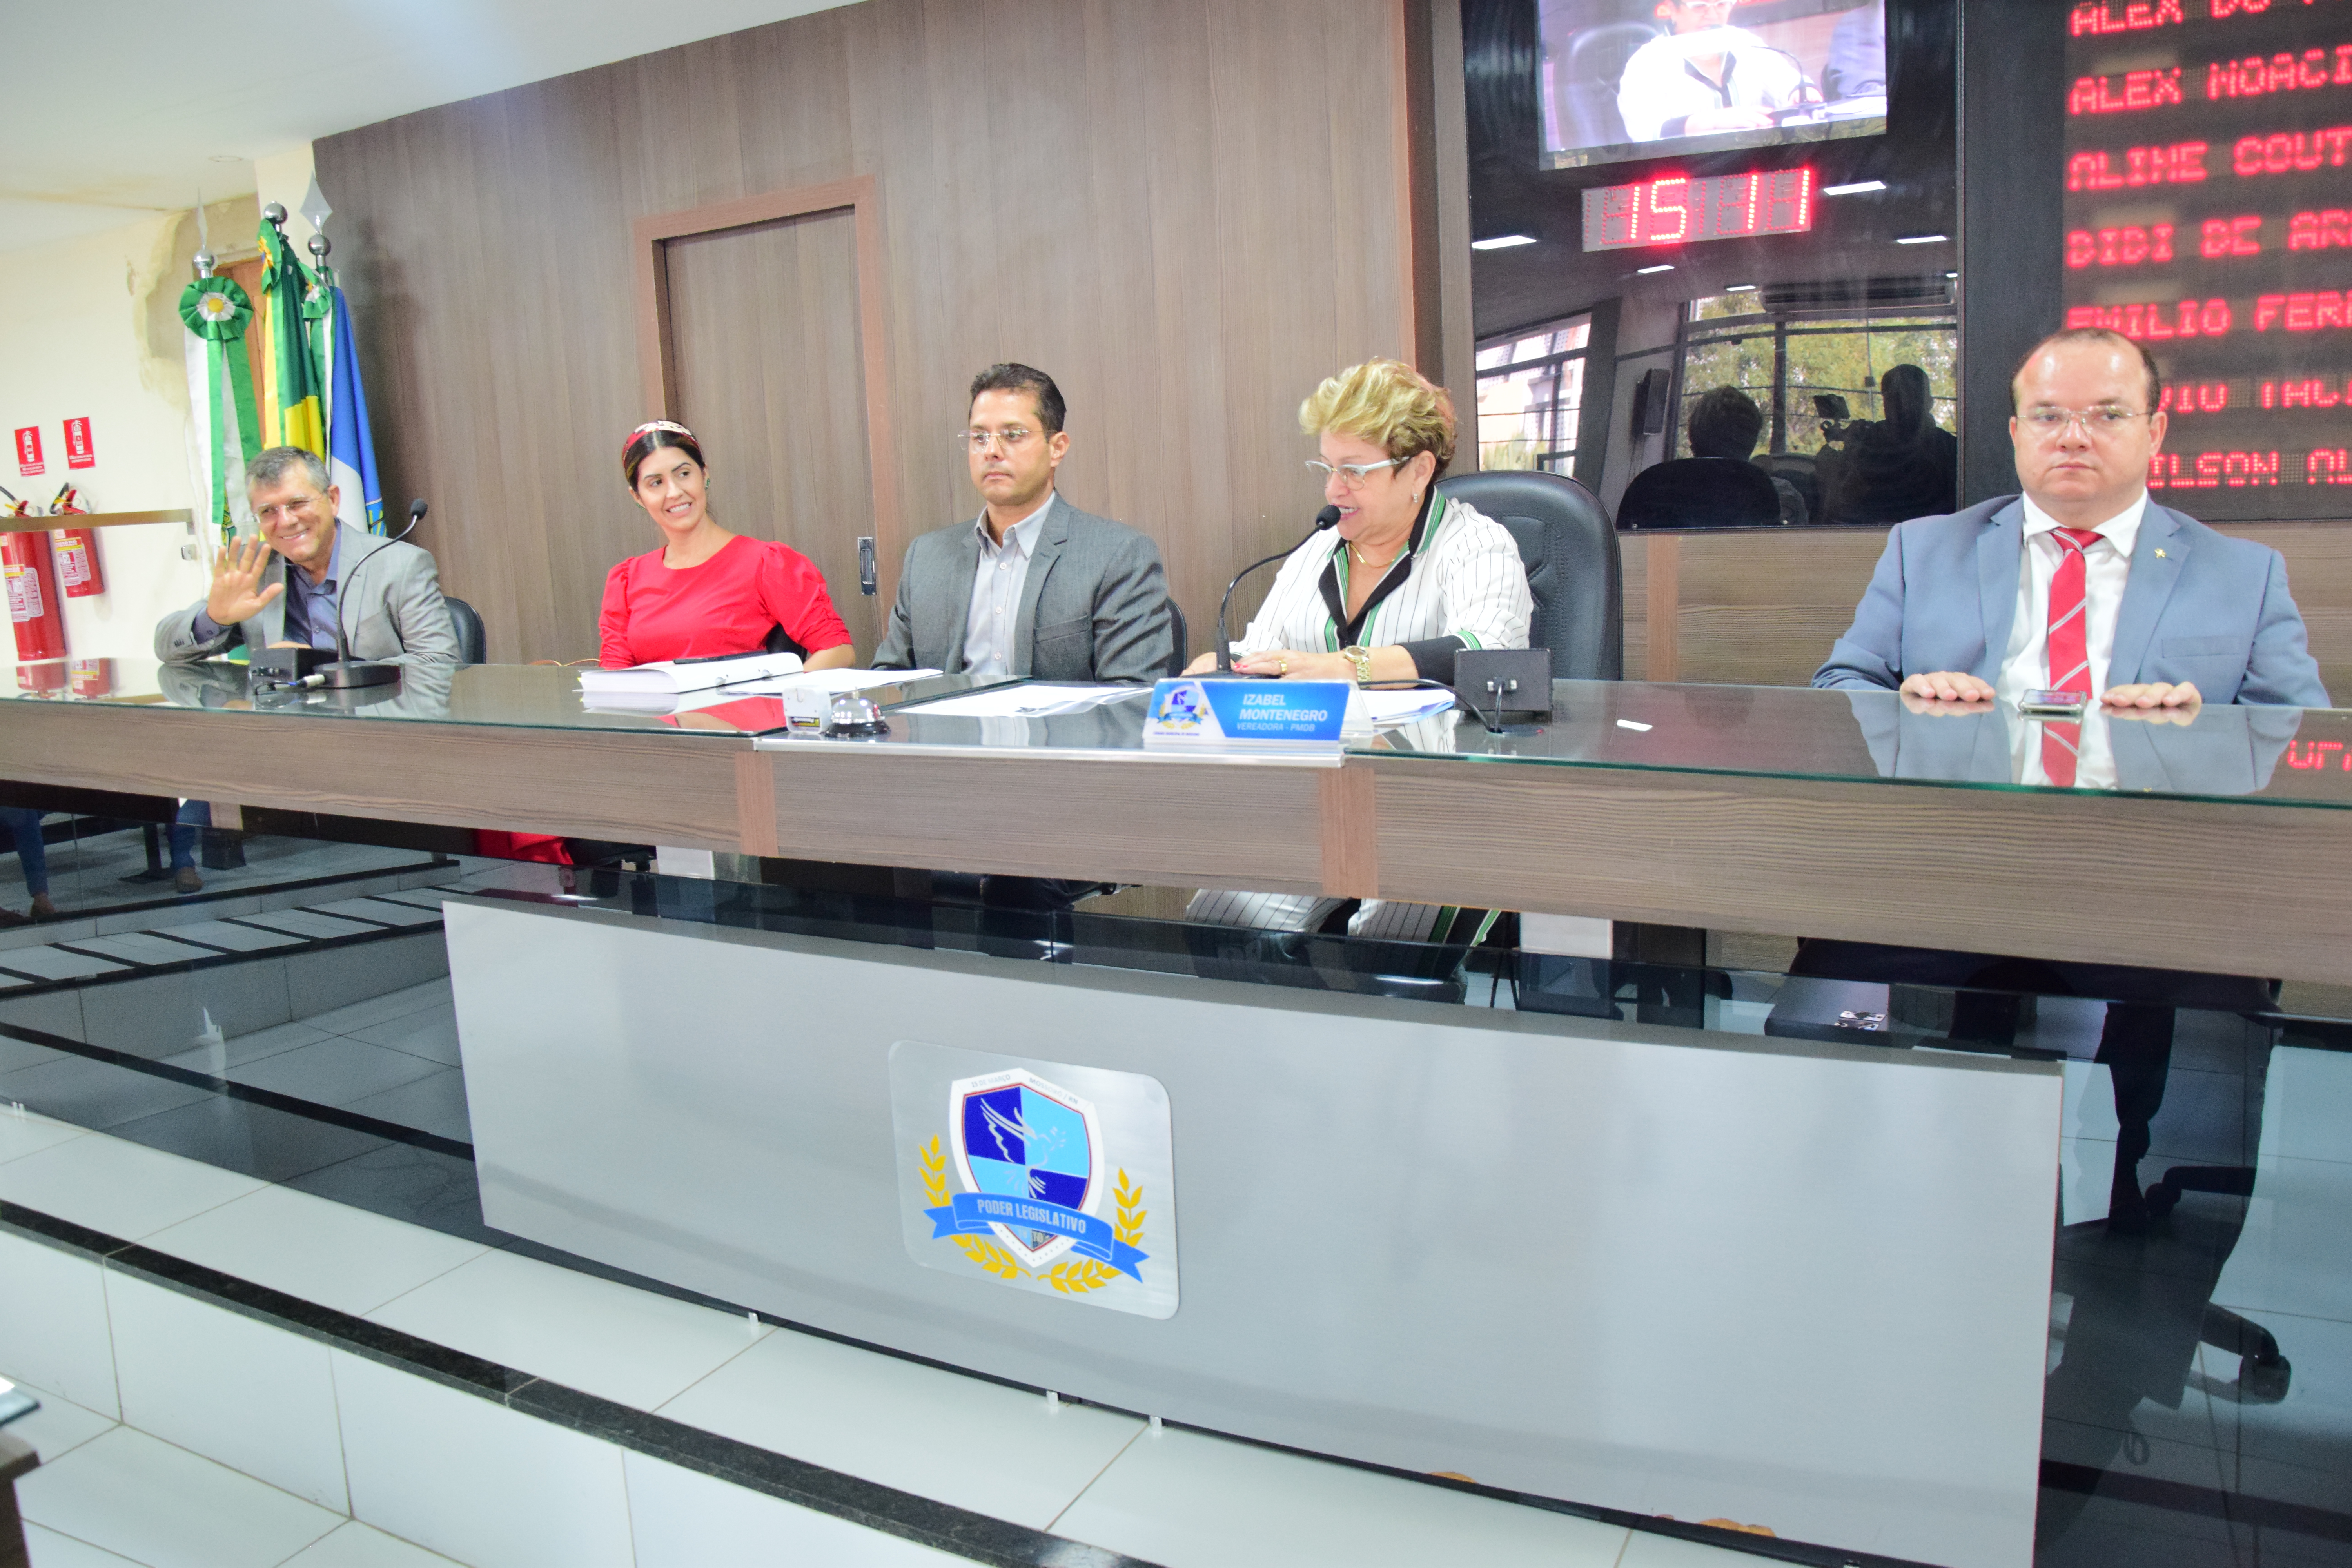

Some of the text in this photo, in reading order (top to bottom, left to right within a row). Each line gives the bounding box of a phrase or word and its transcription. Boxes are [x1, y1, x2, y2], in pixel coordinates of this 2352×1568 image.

[2070, 67, 2181, 114] ALEX
[2067, 210, 2352, 267] DIDI DE AR
[2255, 290, 2352, 332] FER
[2147, 450, 2278, 488] ILSON
[1239, 708, 1328, 721] MONTENEGRO
[1243, 694, 1286, 706] IZABEL
[1237, 722, 1283, 731] VEREADORA
[1290, 723, 1315, 731] PMDB
[988, 1074, 1010, 1085] MARÇO
[977, 1199, 1086, 1234] PODER LEGISLATIVO
